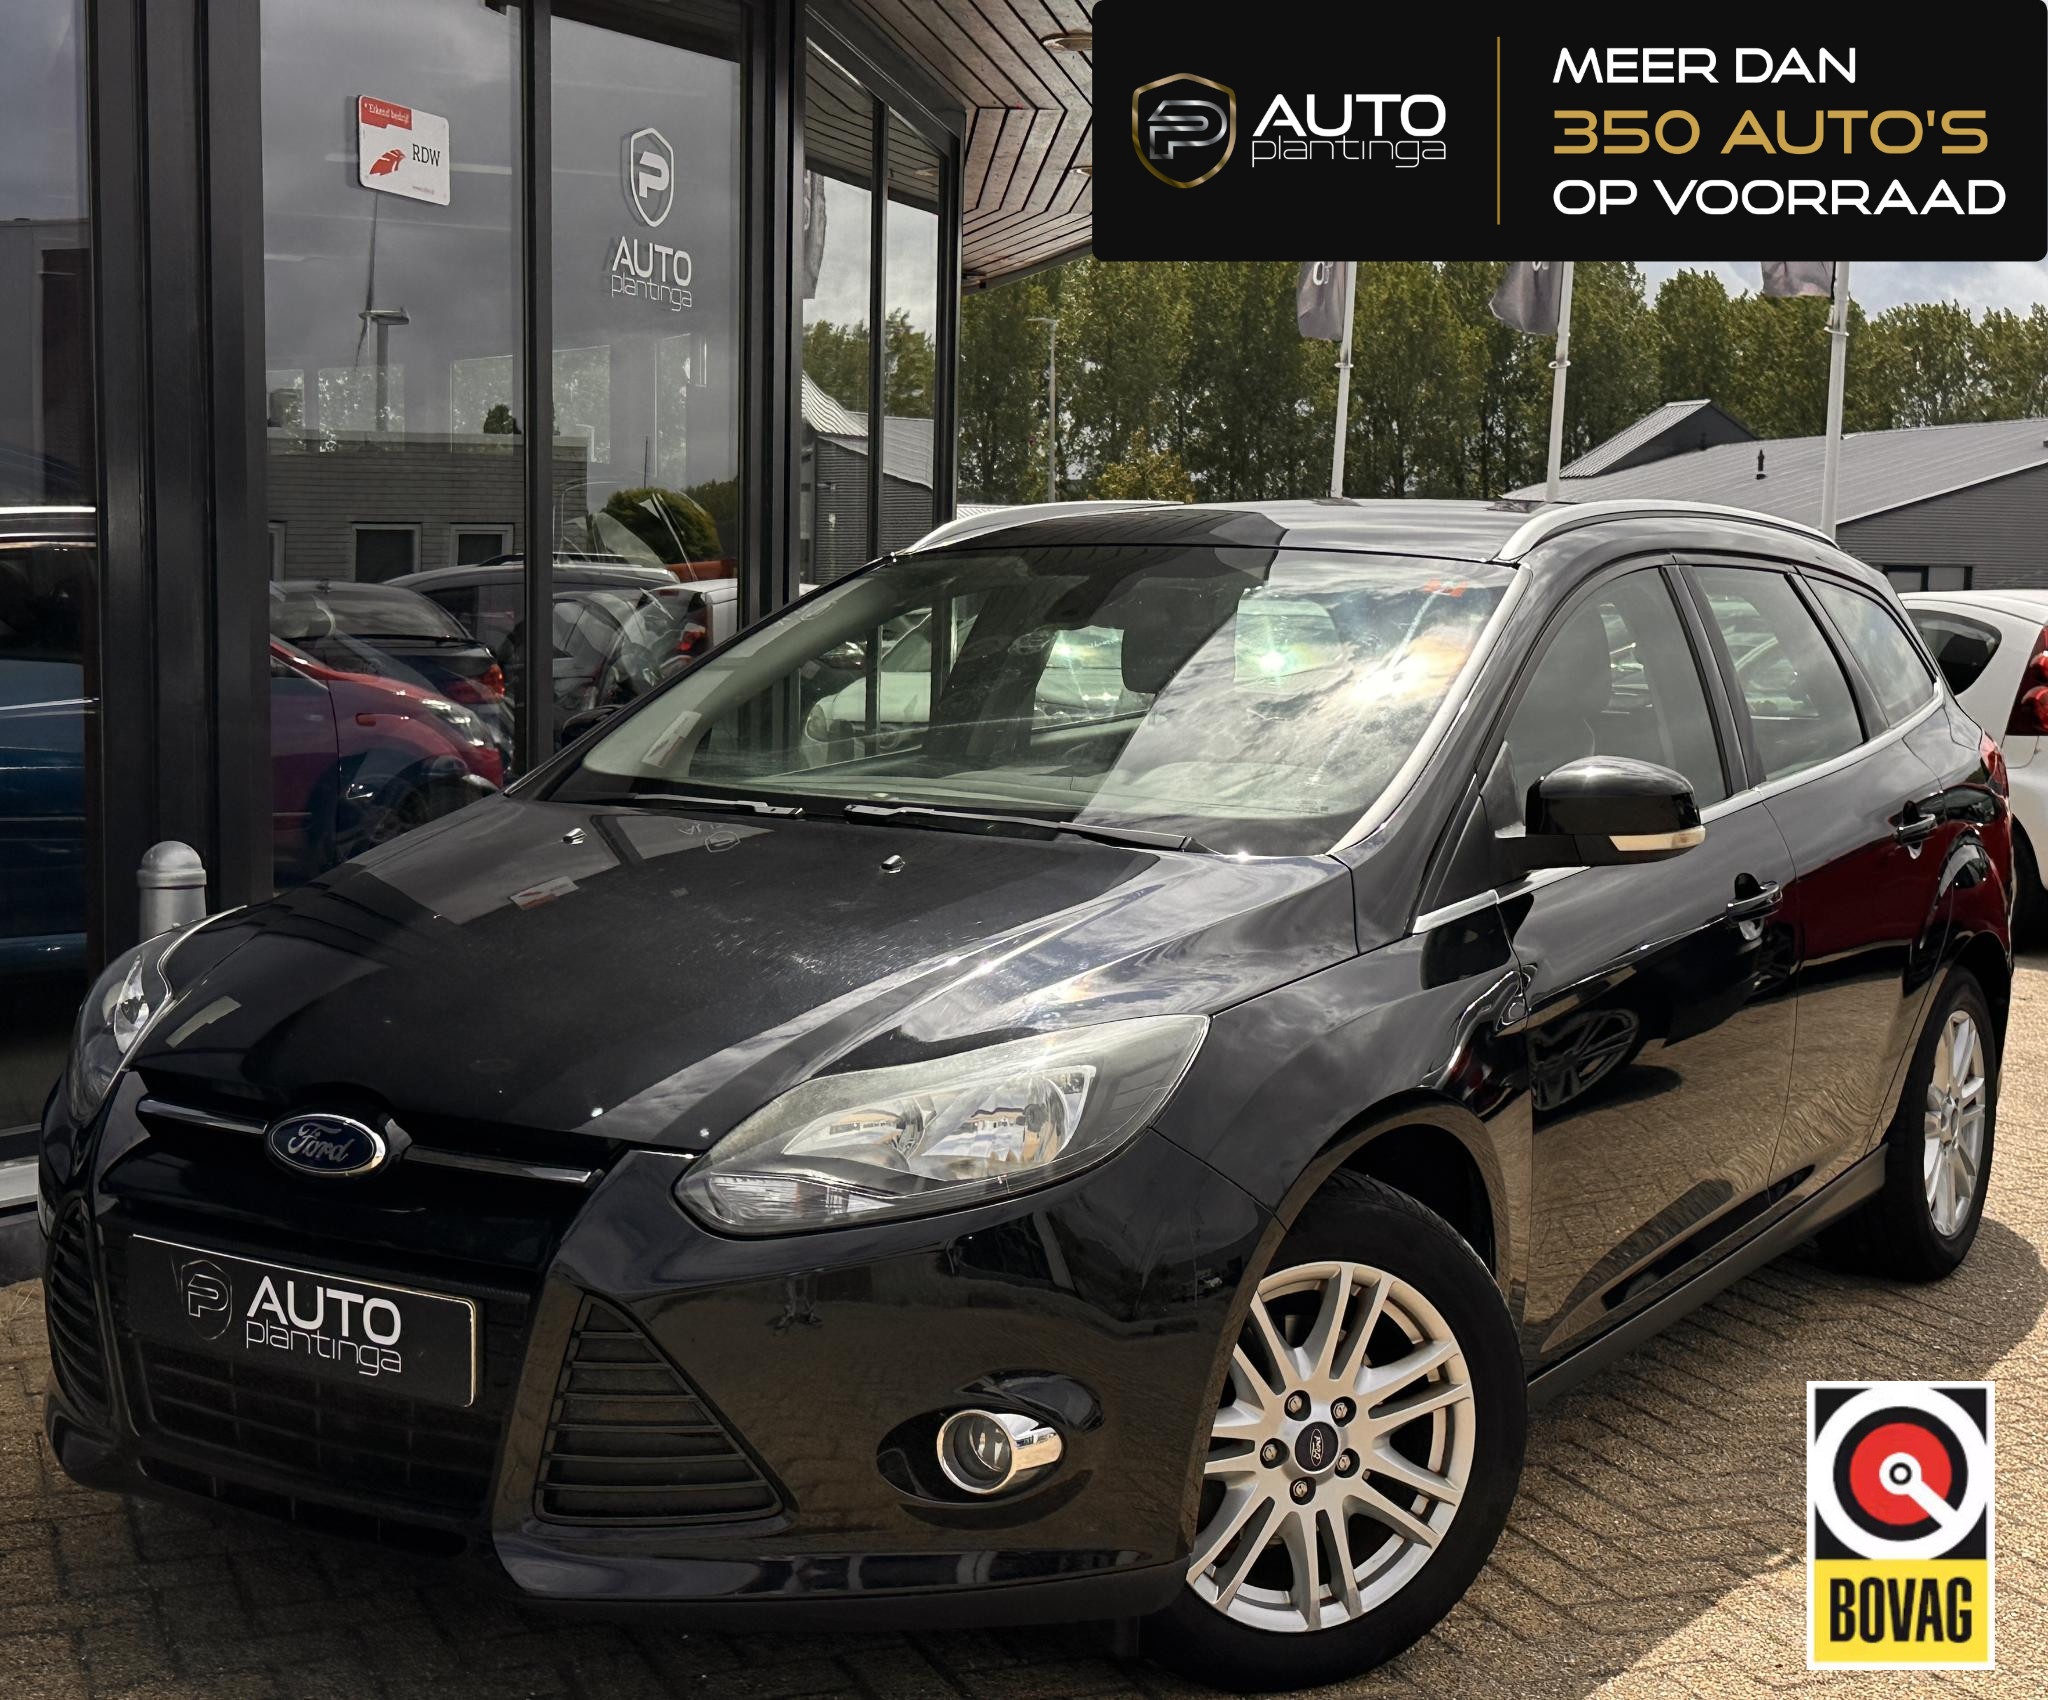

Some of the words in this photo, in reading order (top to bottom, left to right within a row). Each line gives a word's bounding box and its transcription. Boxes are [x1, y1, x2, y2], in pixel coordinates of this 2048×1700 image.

[412, 143, 441, 167] RDW
[612, 235, 692, 287] AUTO
[611, 272, 693, 312] plantinga
[287, 1122, 354, 1163] Ford
[246, 1275, 401, 1346] AUTO
[246, 1318, 401, 1376] plantinga
